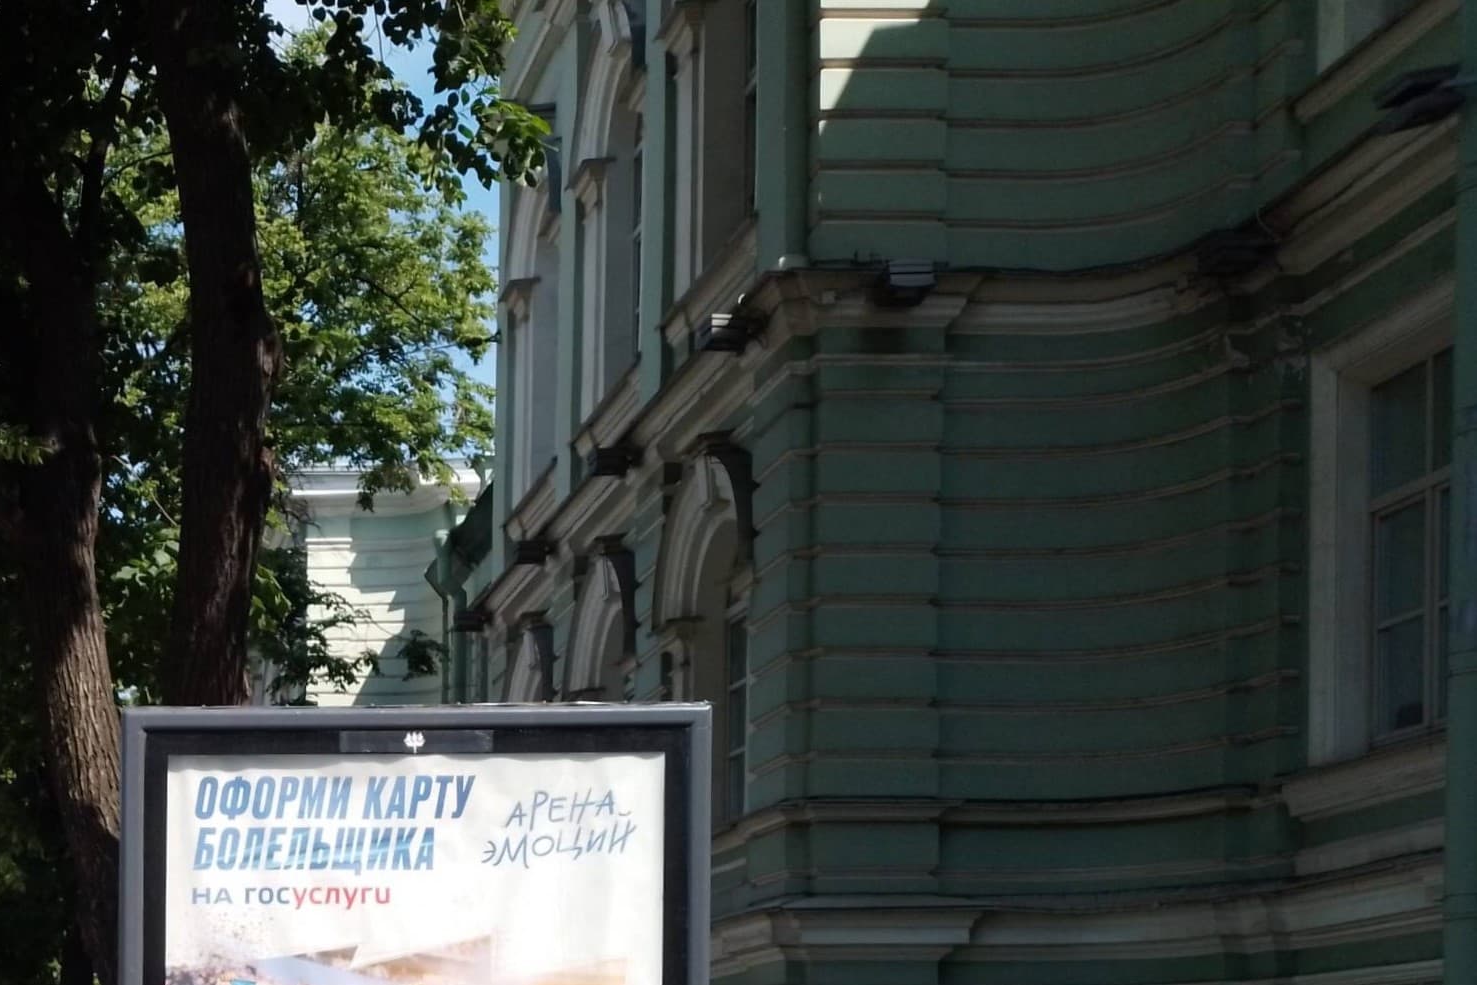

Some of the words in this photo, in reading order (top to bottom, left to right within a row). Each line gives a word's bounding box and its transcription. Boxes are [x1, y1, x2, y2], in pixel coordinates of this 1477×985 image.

[195, 775, 353, 820] ОФОРМИ
[362, 774, 476, 820] КАРТУ
[504, 788, 615, 831] АРЕНА
[193, 826, 435, 875] БОЛЕЛЬЩИКА
[481, 811, 636, 869] ЭМОЦИЙ
